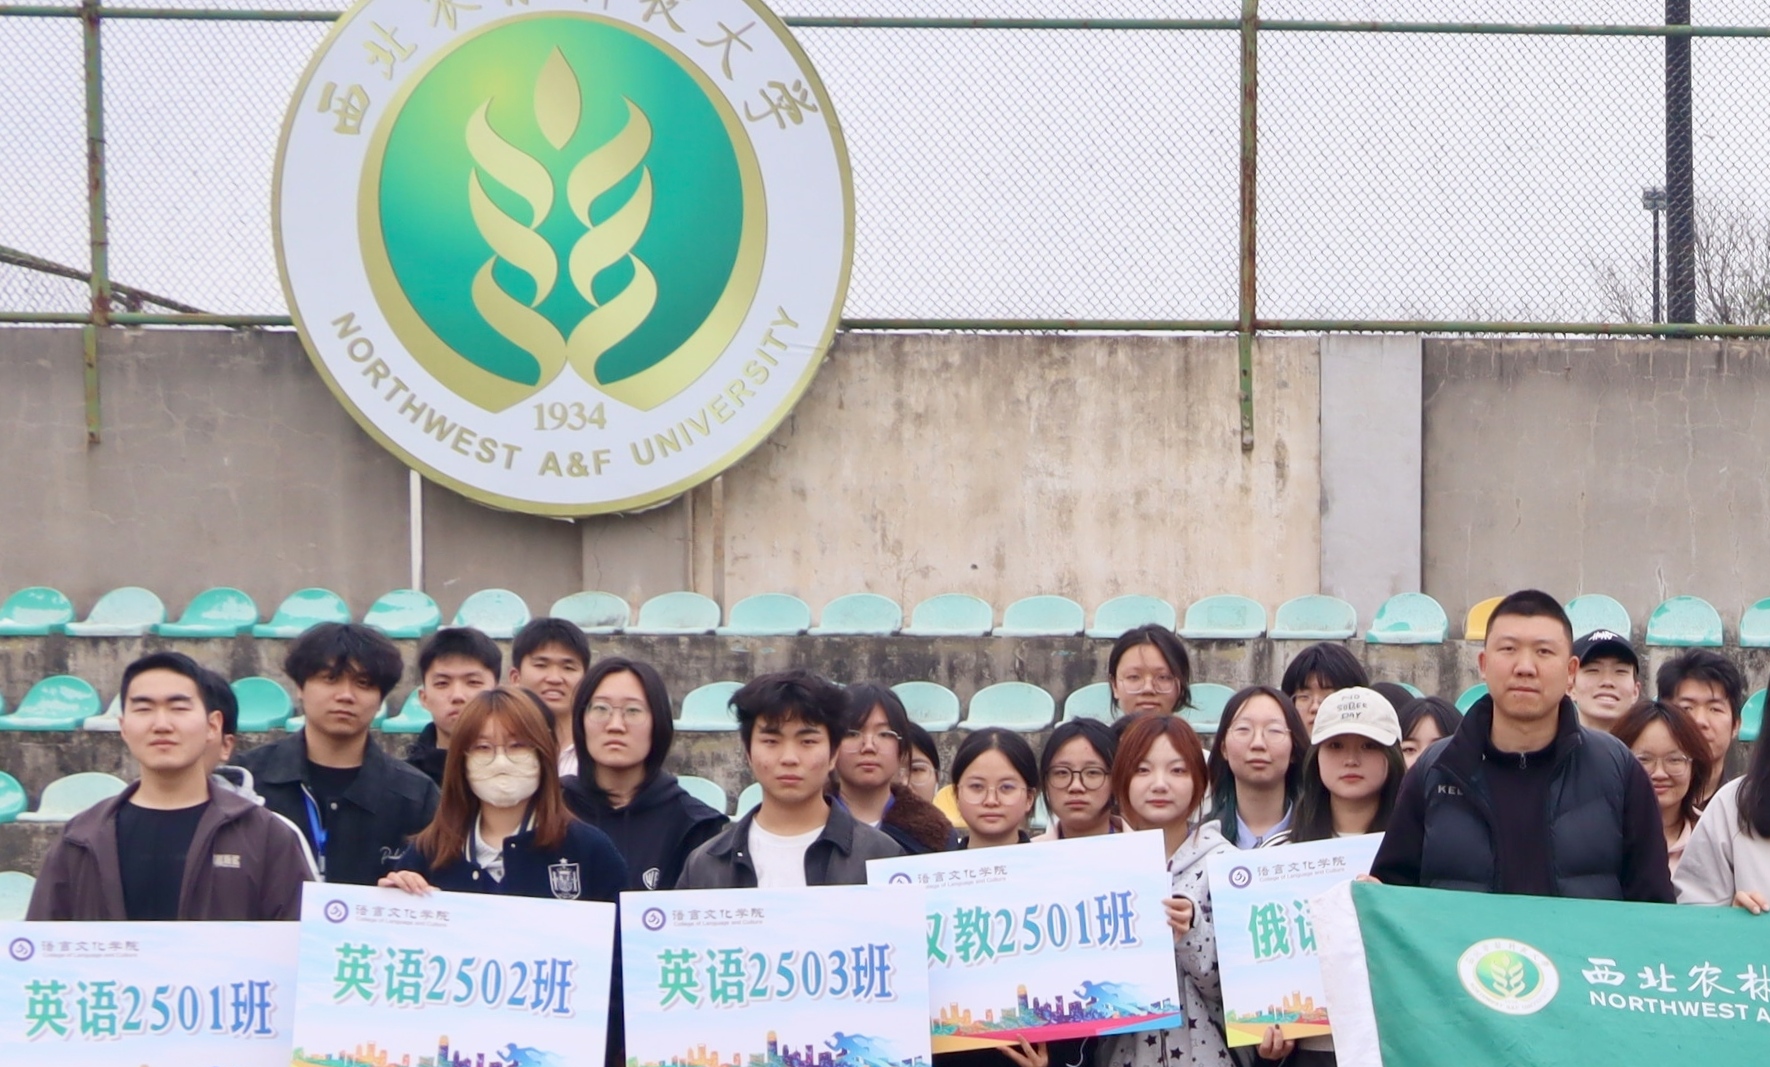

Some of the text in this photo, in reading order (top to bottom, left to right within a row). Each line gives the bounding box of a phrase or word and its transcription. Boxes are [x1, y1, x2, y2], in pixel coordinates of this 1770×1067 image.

[331, 306, 801, 478] NORTHWEST A&F UNIVERSITY
[532, 401, 607, 431] 1934
[1258, 856, 1346, 876] 语言文化学院
[333, 942, 572, 1013] 英语2502班
[658, 943, 892, 1006] 英语2503班
[25, 980, 272, 1037] 英语2501班
[1589, 991, 1749, 1020] NORTHWEST
